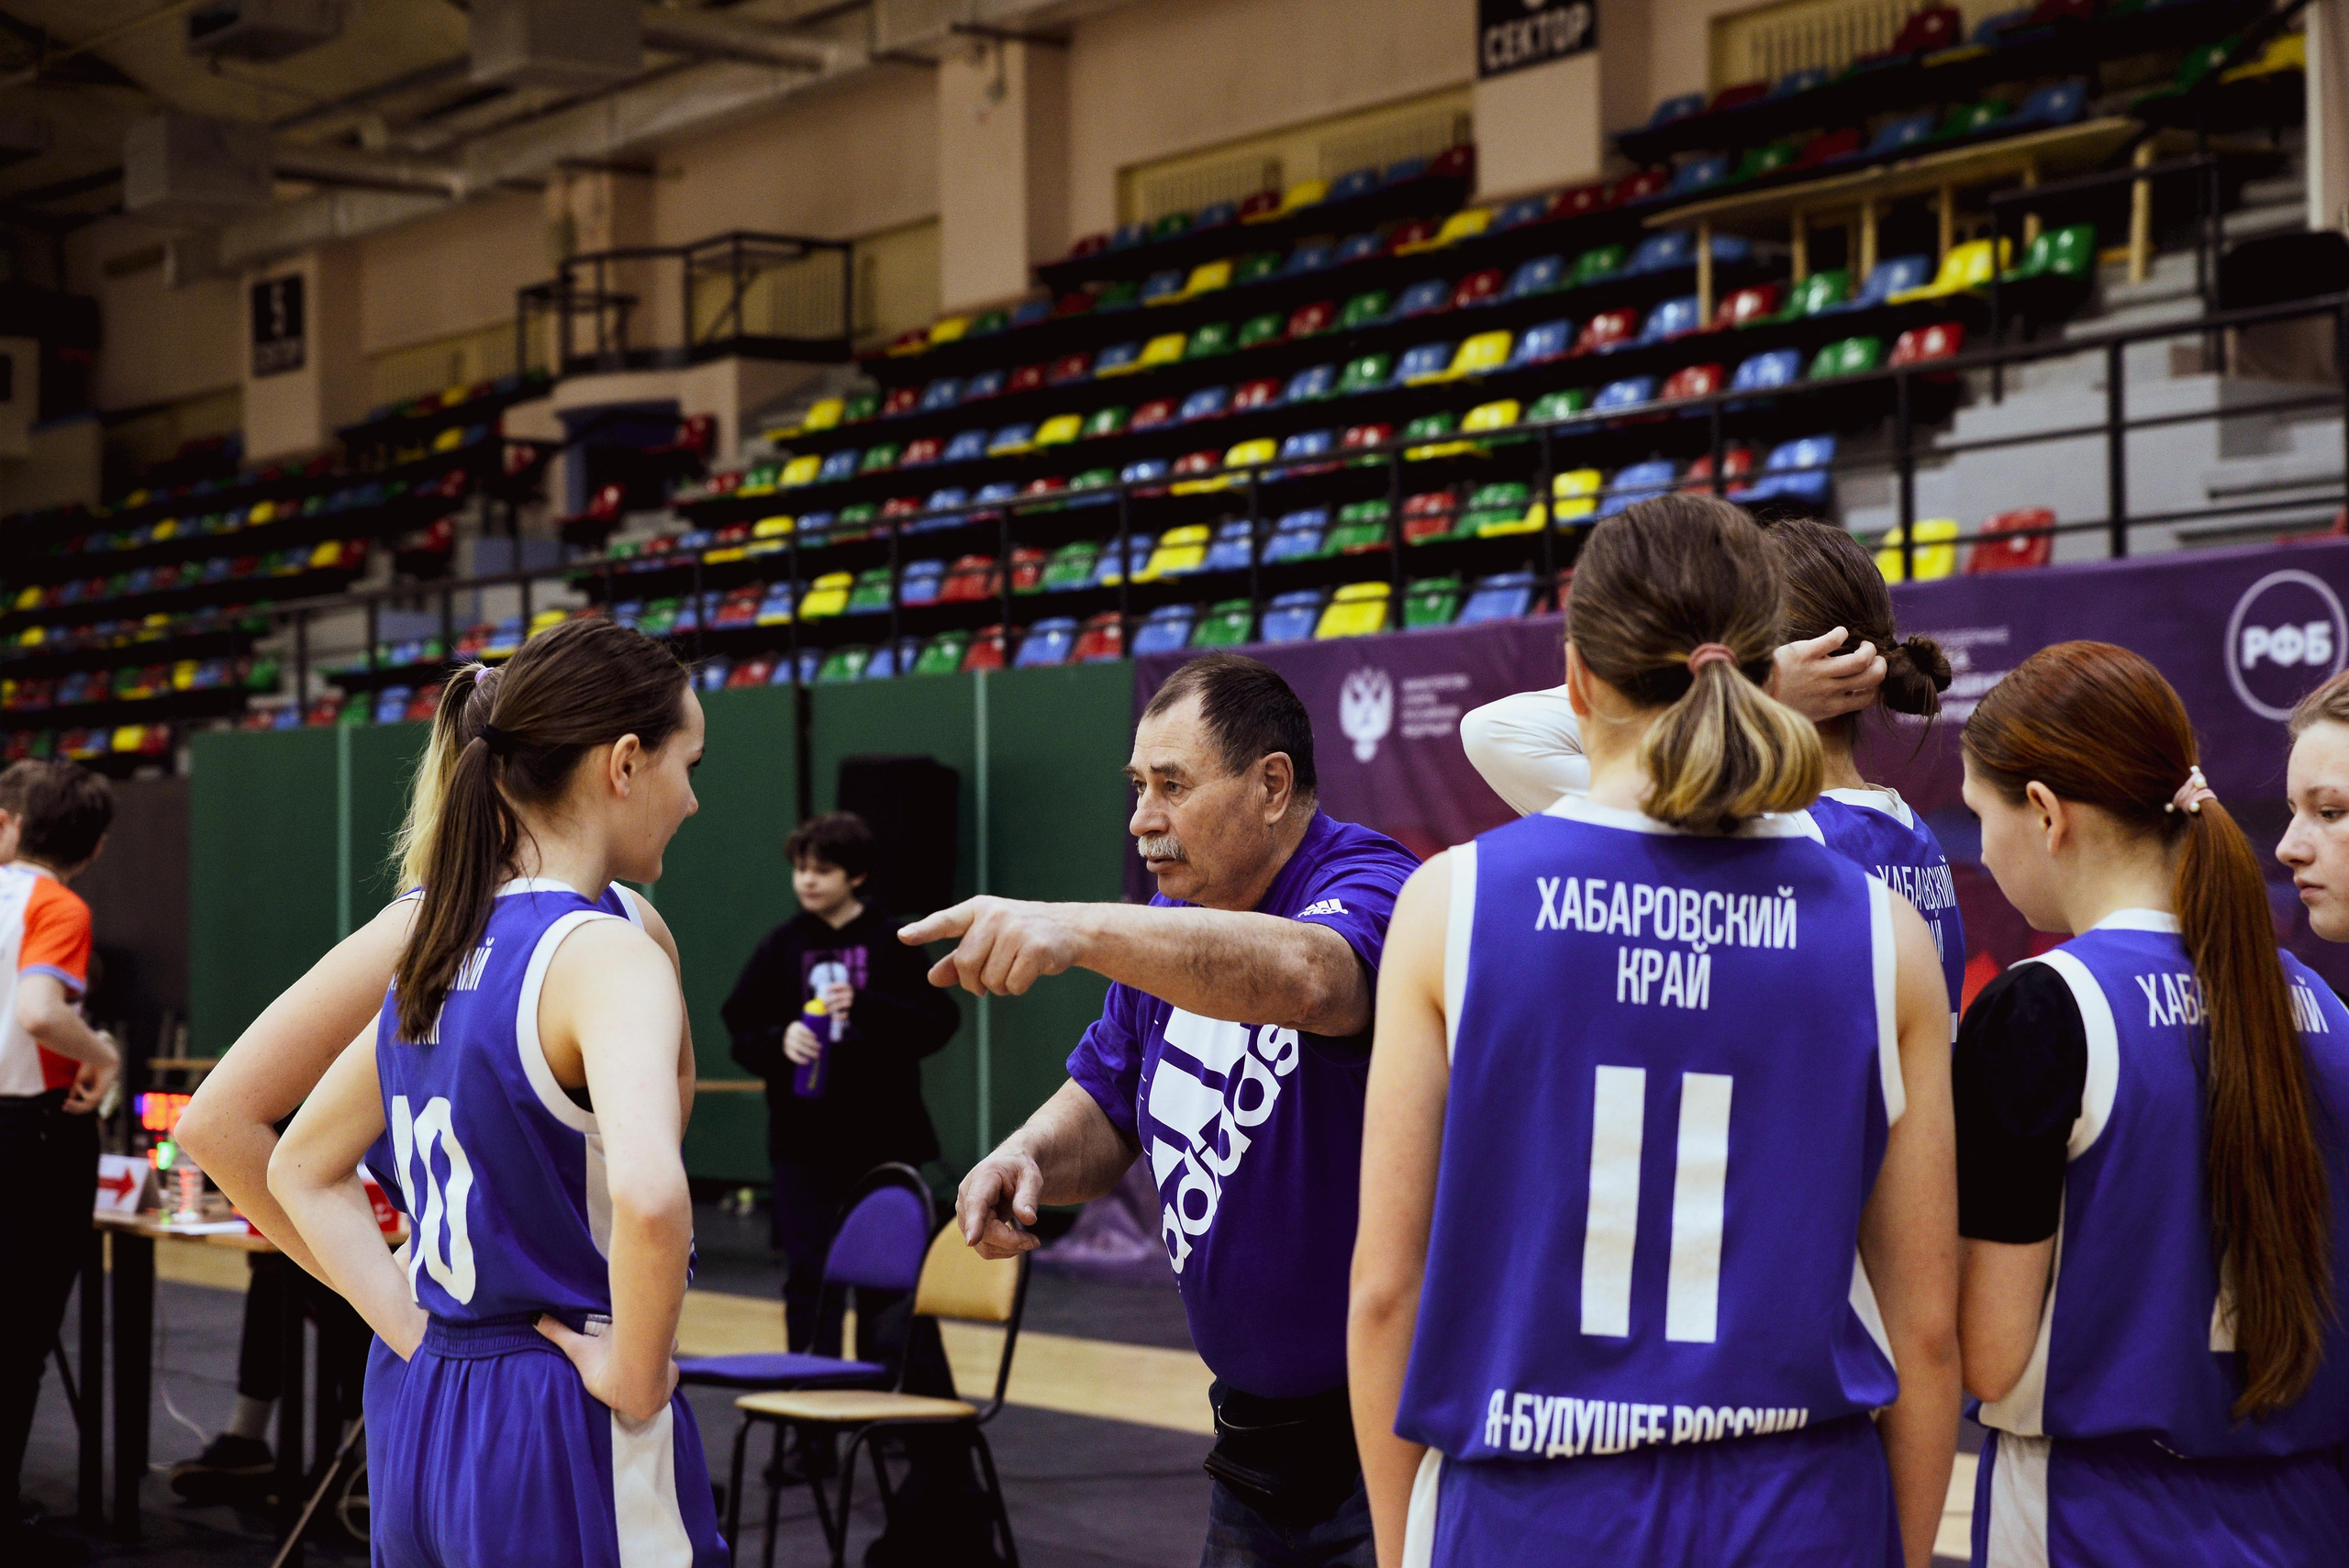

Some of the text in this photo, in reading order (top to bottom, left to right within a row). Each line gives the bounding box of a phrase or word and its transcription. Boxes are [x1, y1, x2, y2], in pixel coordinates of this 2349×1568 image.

[1484, 3, 1590, 69] СЕКТОР
[2241, 621, 2333, 670] РФБ
[1534, 875, 1798, 950] ХАБАРОВСКИЙ
[1616, 939, 1712, 1010] КРАЙ
[1162, 1024, 1299, 1274] adidas
[1579, 1063, 1734, 1344] 11
